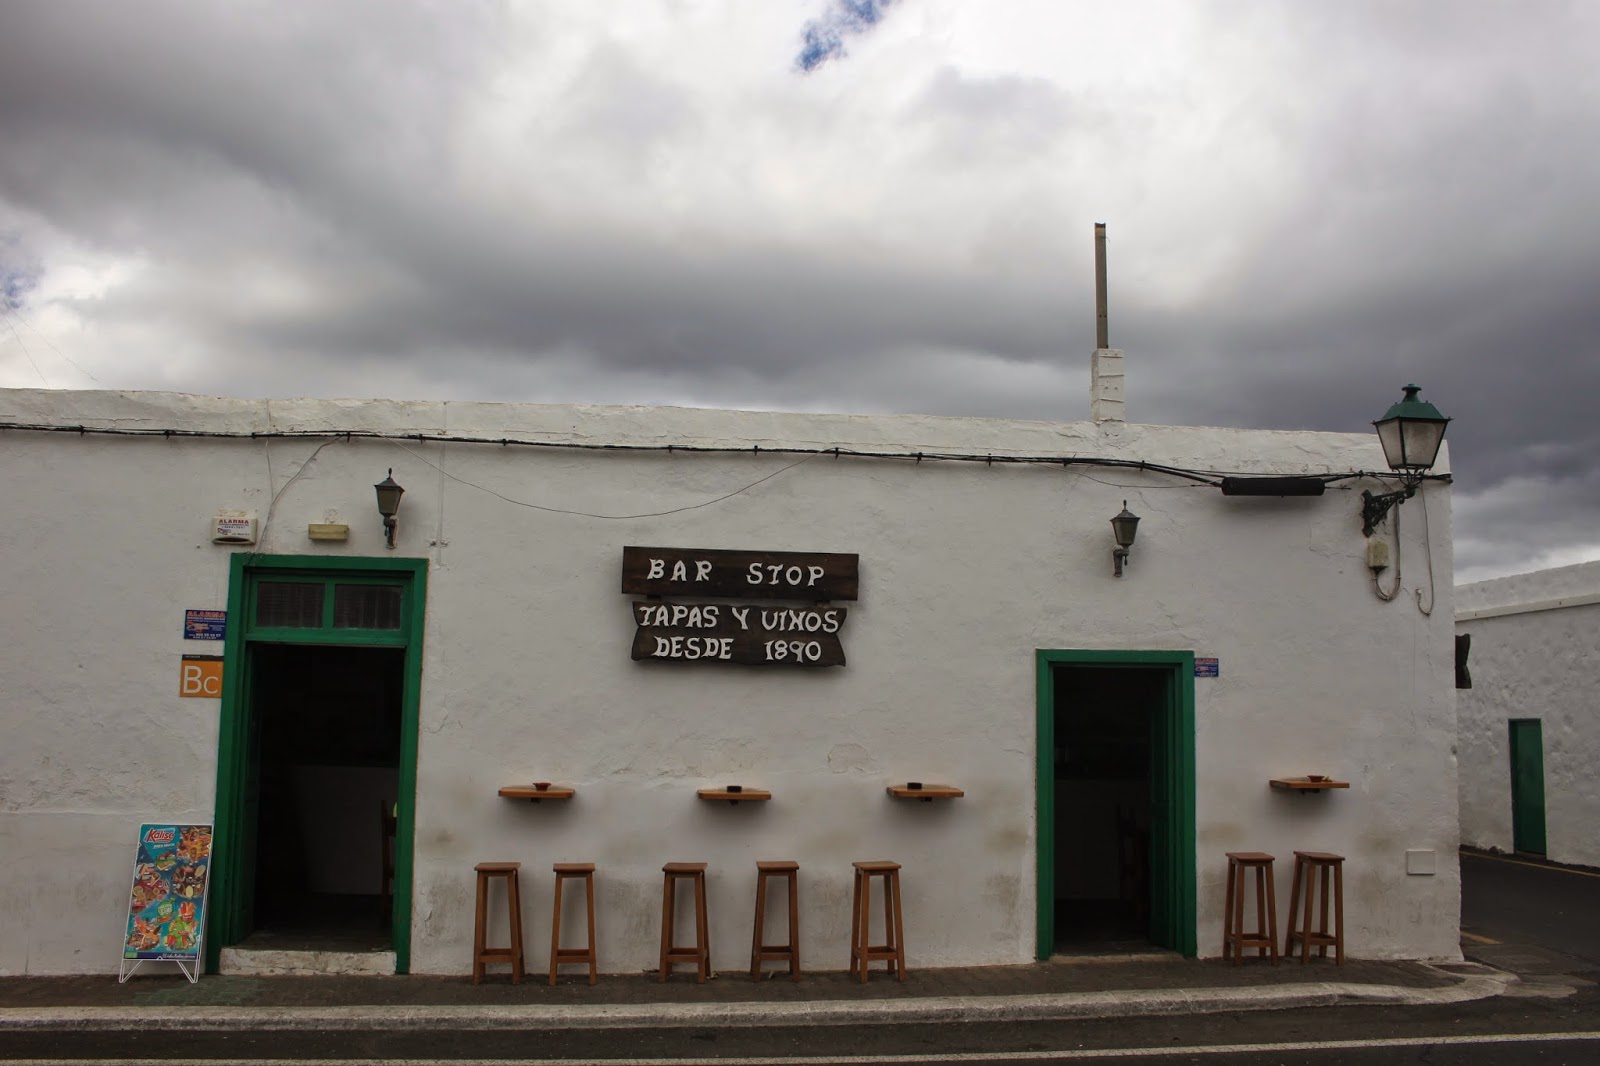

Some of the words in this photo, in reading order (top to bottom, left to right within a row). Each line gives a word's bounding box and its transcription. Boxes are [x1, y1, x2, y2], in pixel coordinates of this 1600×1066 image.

[647, 558, 712, 582] BAR
[746, 562, 825, 587] STOP
[639, 605, 719, 628] TAPAS
[732, 607, 749, 630] Y
[652, 636, 734, 660] DESDE
[764, 640, 821, 663] 1890
[146, 828, 175, 842] Kalise
